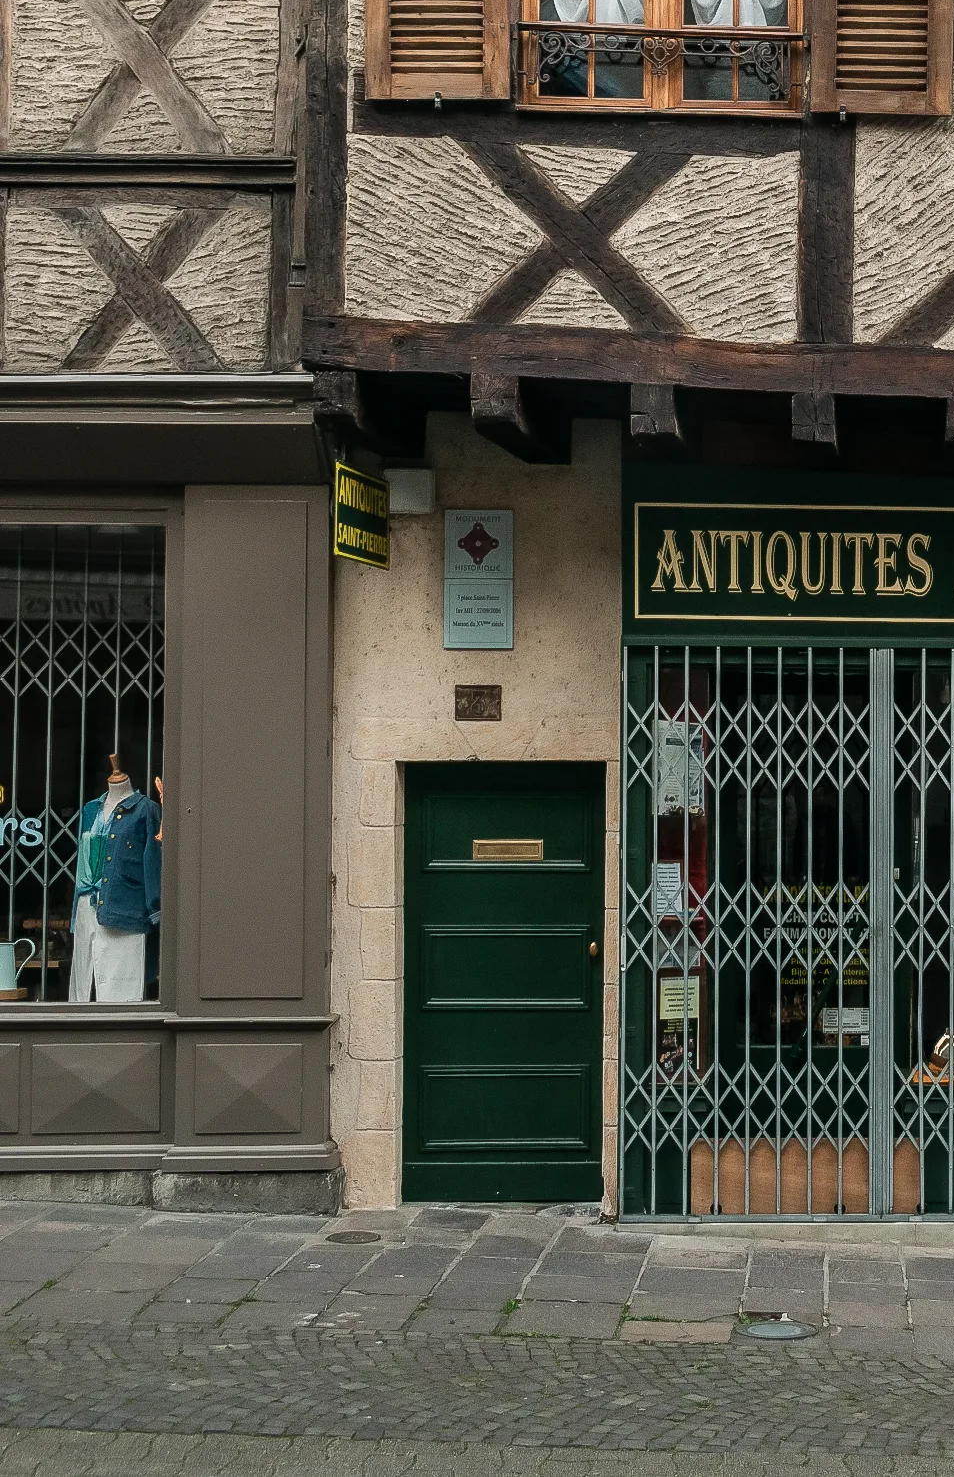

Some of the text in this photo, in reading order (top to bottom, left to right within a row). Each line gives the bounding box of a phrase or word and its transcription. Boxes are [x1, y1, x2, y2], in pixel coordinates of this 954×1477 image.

[339, 474, 387, 518] ANTIQUITES
[455, 515, 502, 523] MONUMENT
[338, 522, 388, 556] SAINT-PIERRE
[454, 564, 501, 572] HISTORIQUE
[650, 528, 932, 602] ANTIQUITES
[791, 968, 817, 977] Bijox
